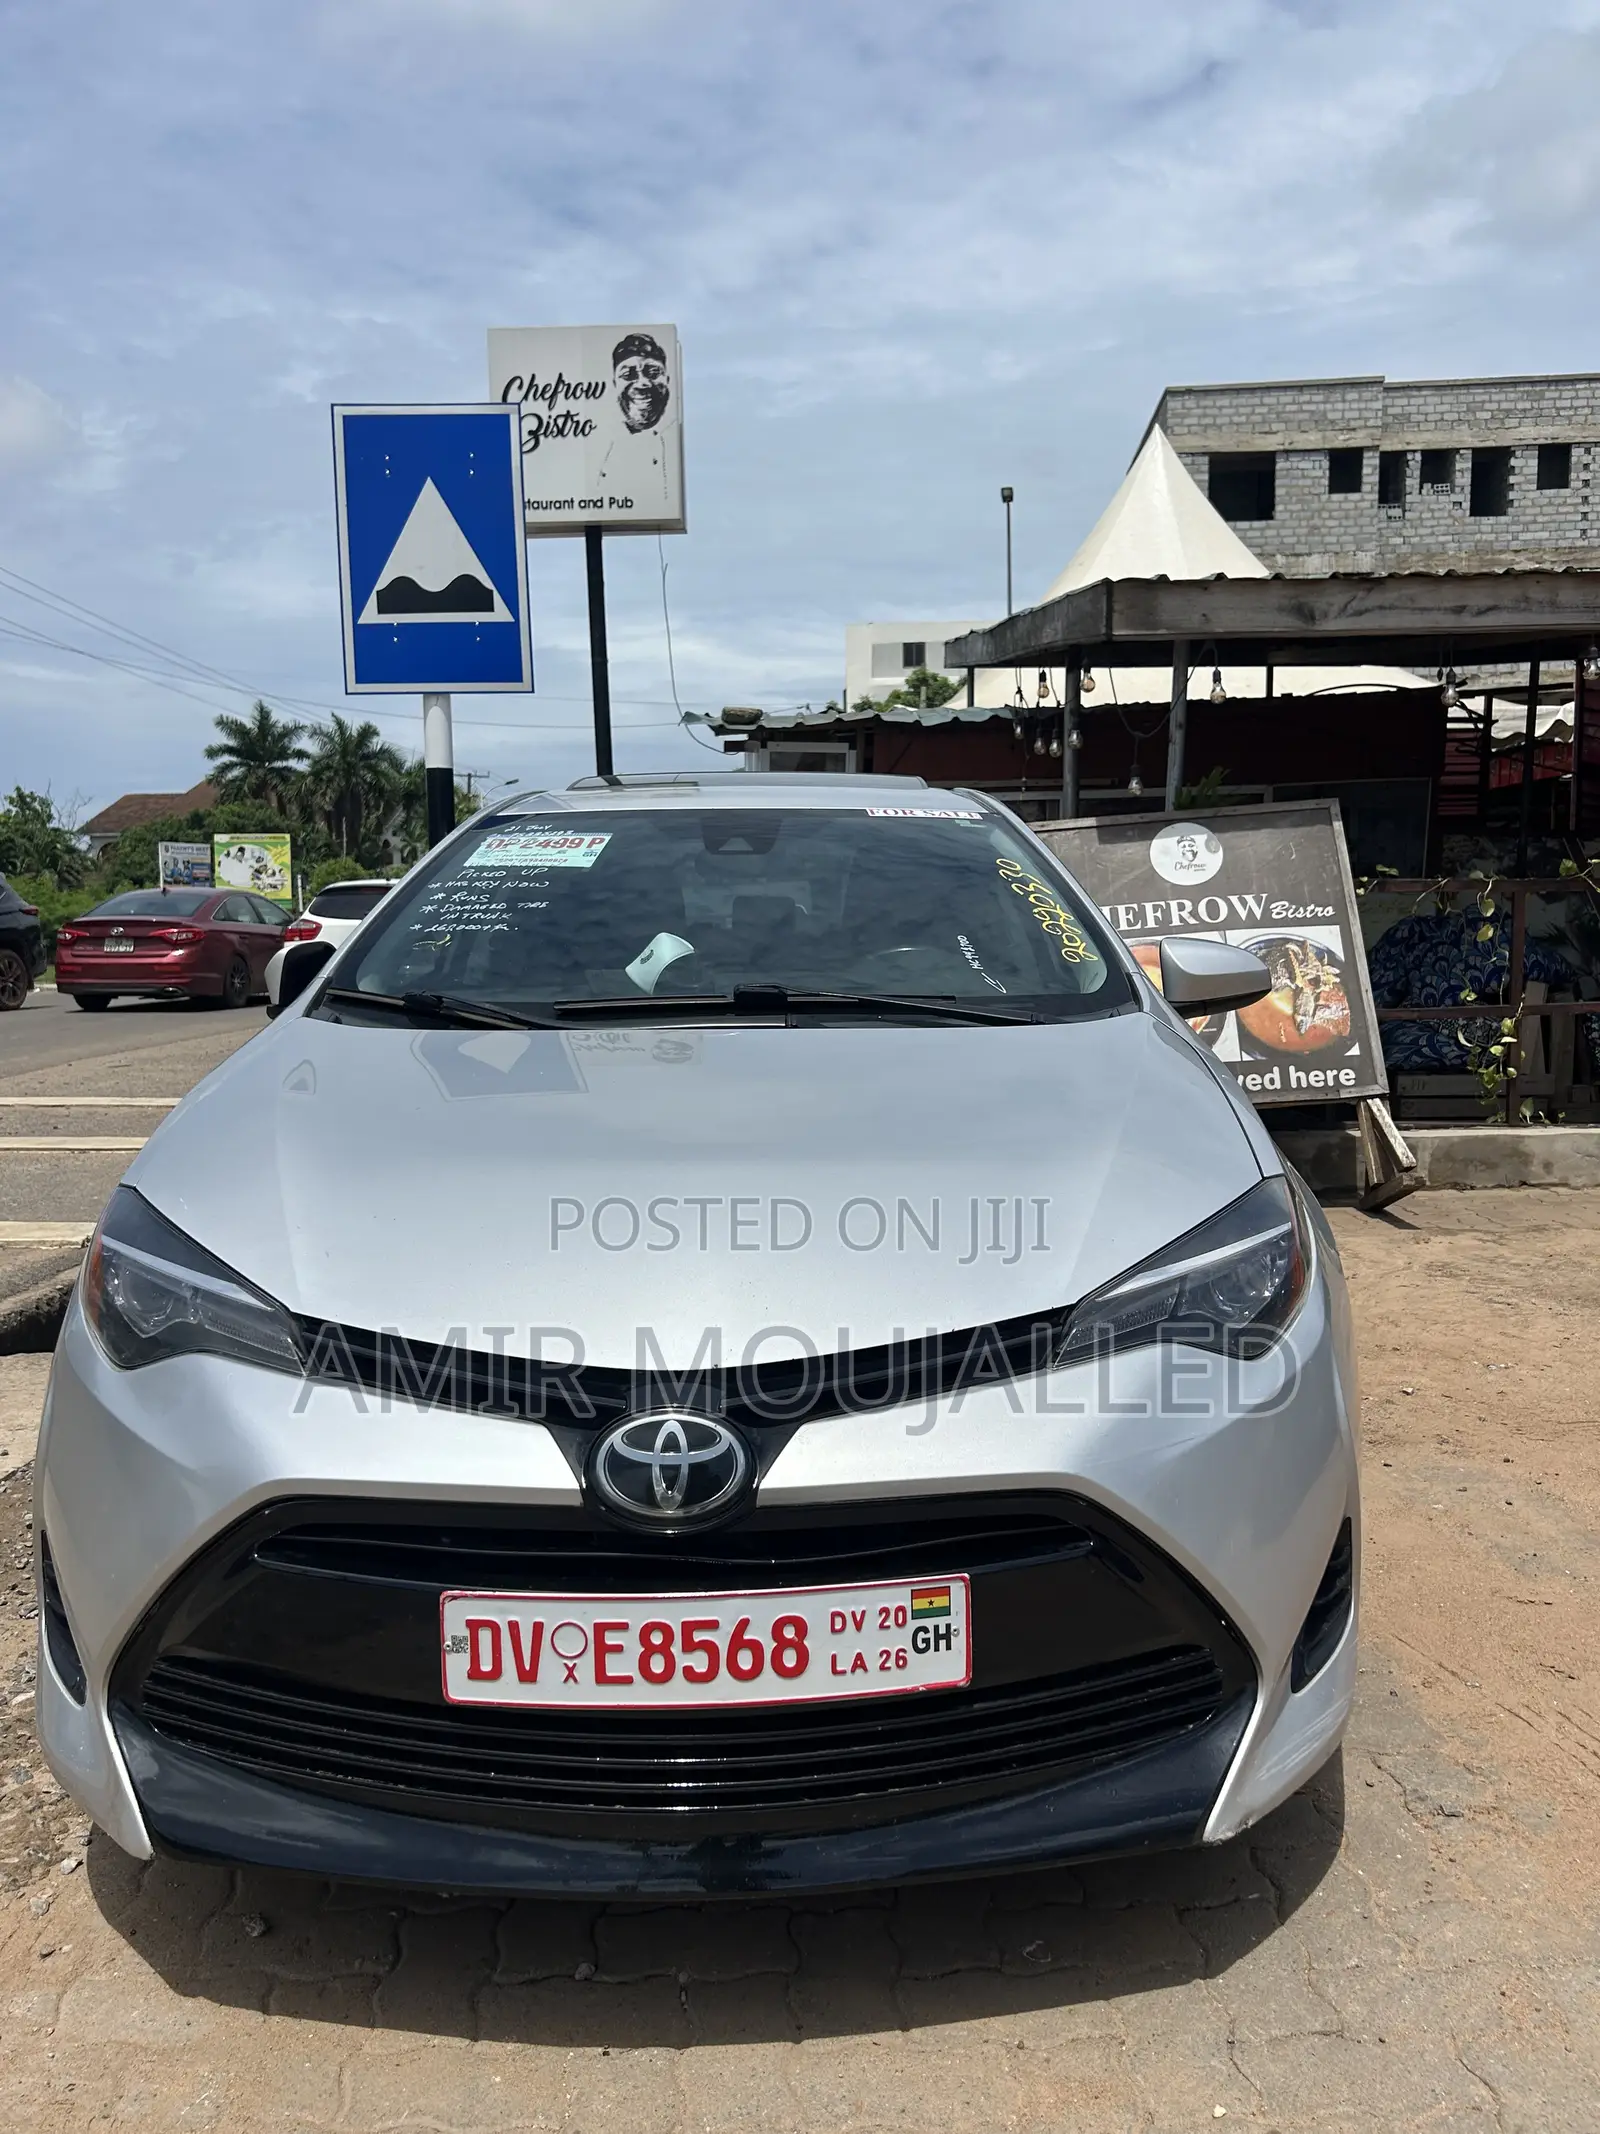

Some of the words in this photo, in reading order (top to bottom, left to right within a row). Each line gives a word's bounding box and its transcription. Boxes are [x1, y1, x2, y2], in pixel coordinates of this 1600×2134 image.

[502, 372, 606, 411] Chefrow
[525, 497, 575, 510] taurant
[578, 496, 603, 509] and
[609, 496, 634, 509] Pub
[868, 808, 917, 816] FOR
[923, 809, 981, 819] SALE
[586, 837, 606, 849] P
[521, 867, 549, 877] UP
[503, 881, 550, 889] NOW
[1269, 901, 1336, 920] Bistro
[1289, 1065, 1356, 1089] here
[830, 1609, 867, 1635] DV
[878, 1604, 908, 1629] 20
[911, 1622, 952, 1655] GH
[594, 1614, 810, 1685] E8568
[830, 1651, 869, 1675] LA
[878, 1647, 908, 1671] 26
